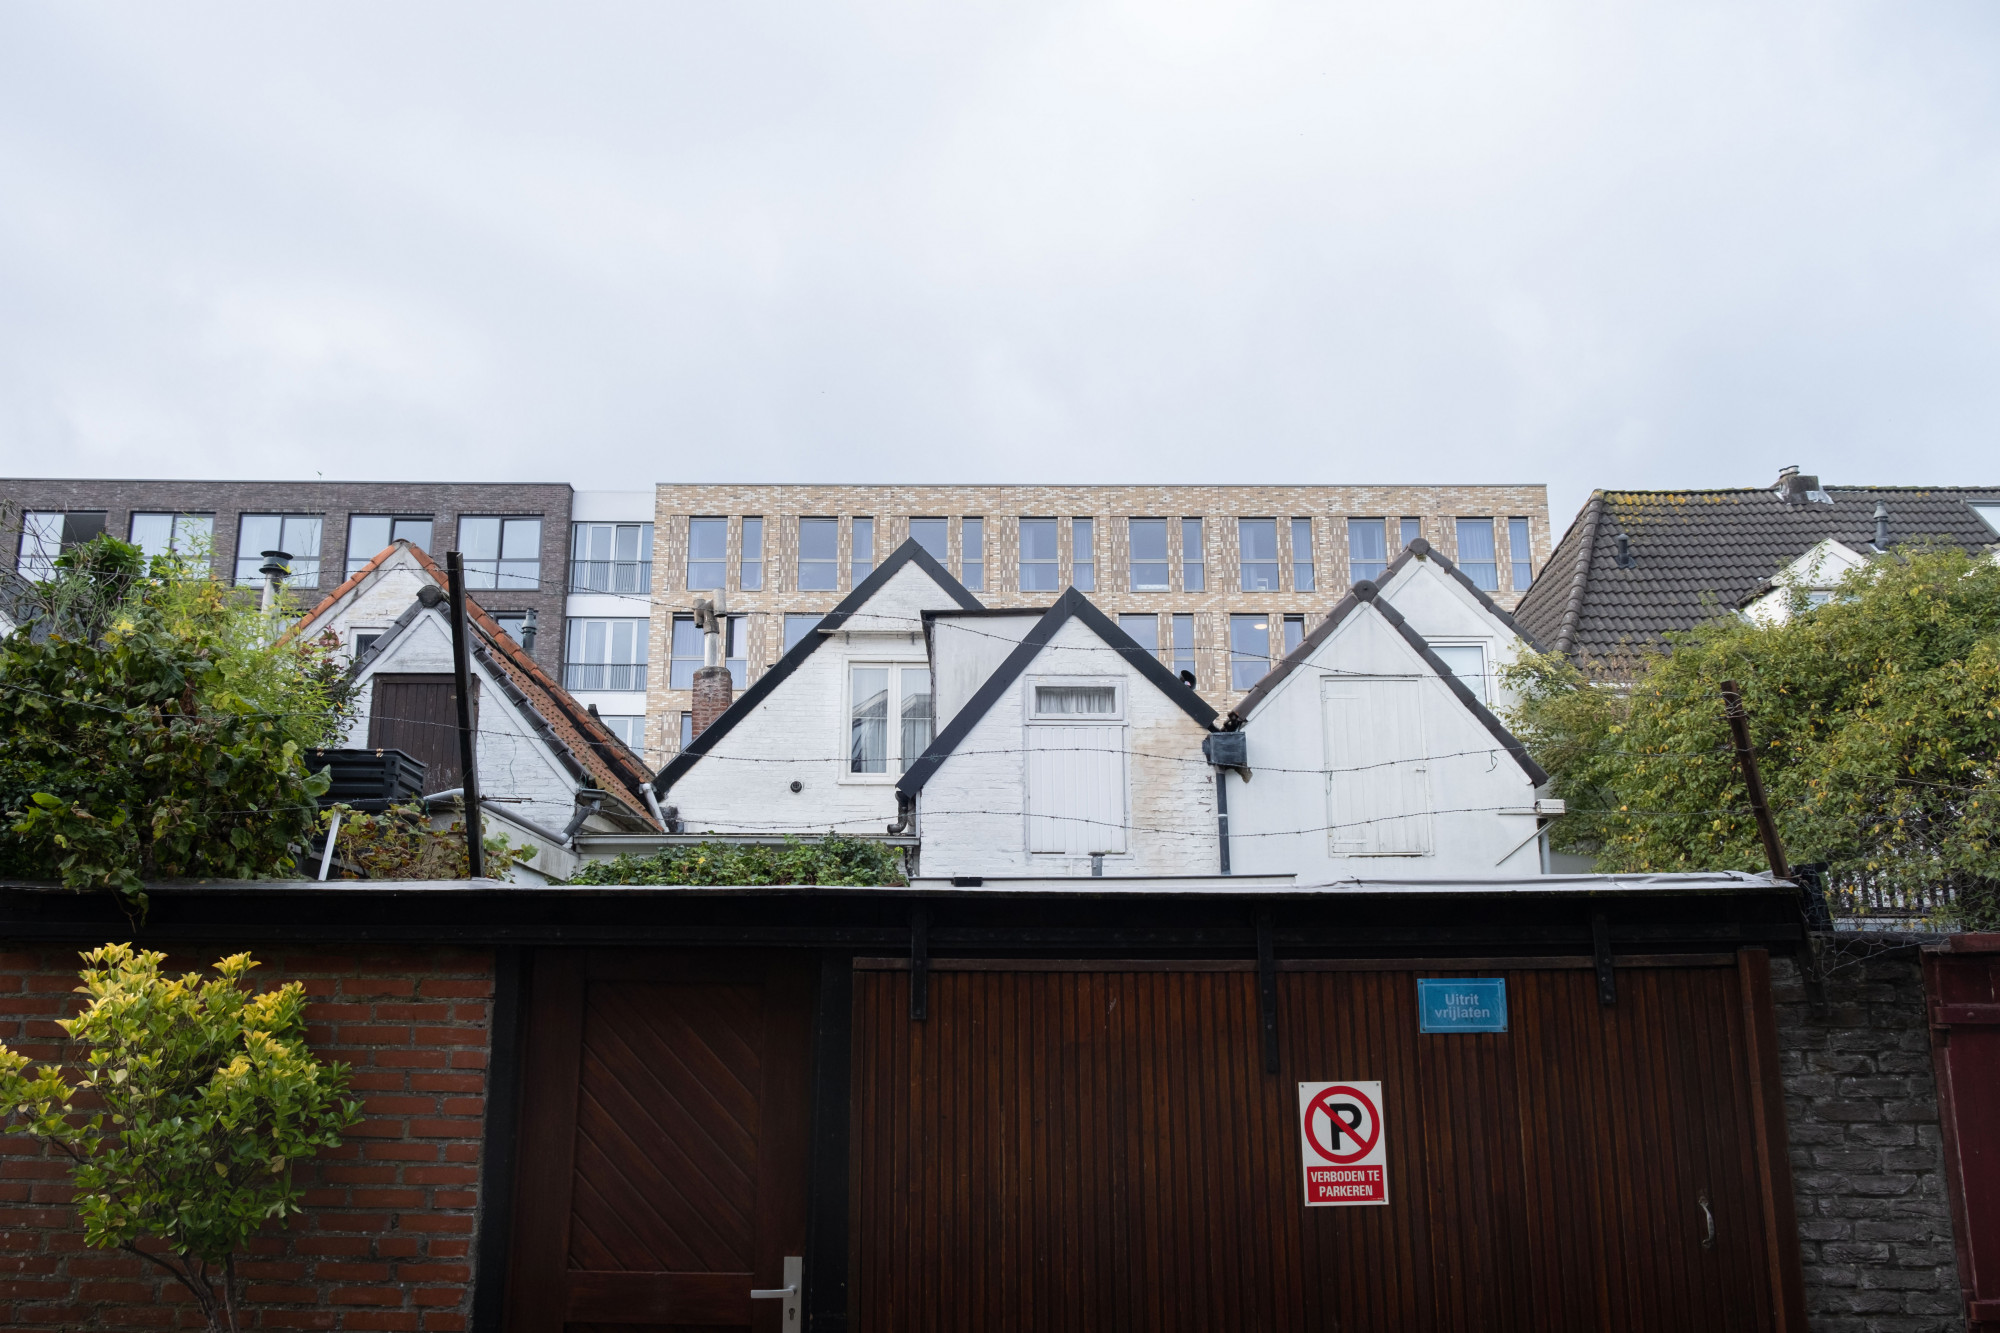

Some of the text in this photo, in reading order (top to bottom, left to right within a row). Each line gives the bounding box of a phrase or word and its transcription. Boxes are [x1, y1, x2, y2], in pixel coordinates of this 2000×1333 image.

[1445, 993, 1479, 1005] Uitrit
[1434, 1006, 1490, 1021] vrijlaten
[1329, 1103, 1362, 1150] P
[1310, 1170, 1380, 1183] VERBODEN TE
[1319, 1185, 1373, 1197] PARKEREN
